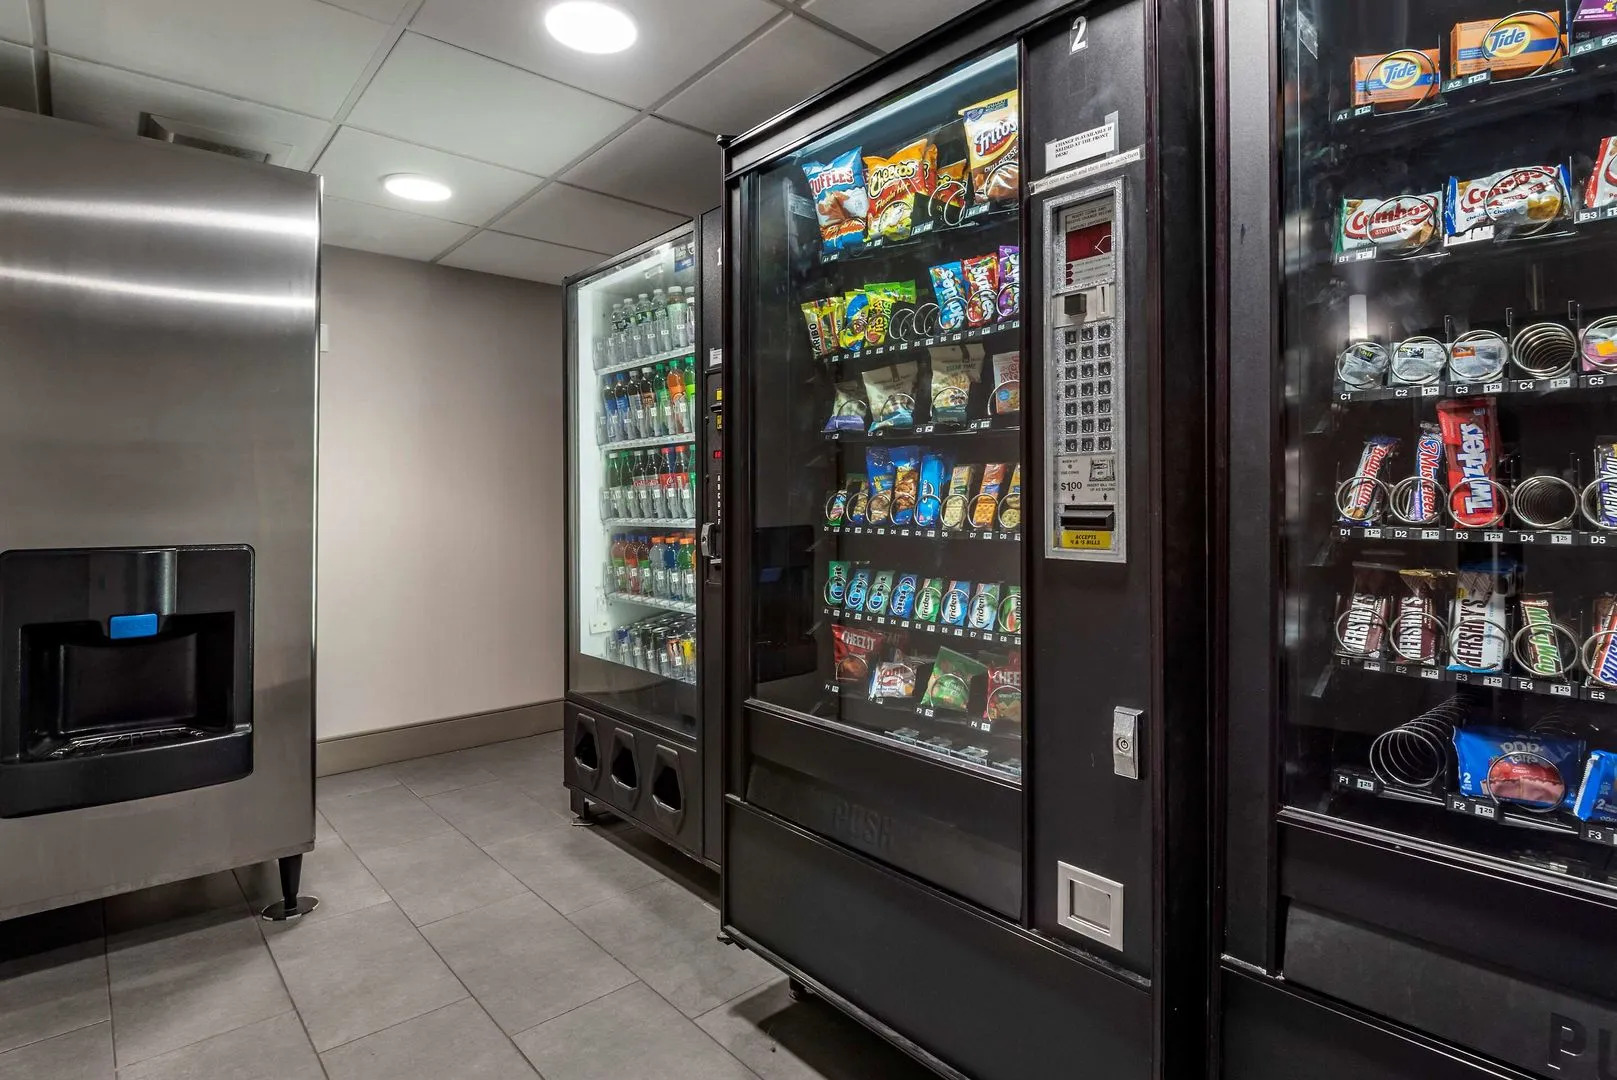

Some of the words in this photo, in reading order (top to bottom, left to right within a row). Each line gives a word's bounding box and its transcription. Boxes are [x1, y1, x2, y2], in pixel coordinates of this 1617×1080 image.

[1072, 15, 1087, 53] 2
[1489, 28, 1526, 52] Tide
[1576, 44, 1592, 53] A3
[1384, 62, 1417, 84] Tide
[1447, 81, 1462, 89] A2
[1337, 113, 1348, 121] A1
[974, 119, 1018, 157] Fritos
[868, 160, 918, 198] Cheetos
[1468, 165, 1556, 205] Combos
[1352, 200, 1429, 230] Combos
[1519, 382, 1534, 390] C4
[1589, 377, 1604, 385] C5
[1395, 389, 1408, 397] C2
[1455, 386, 1468, 394] C3
[1419, 439, 1439, 453] 3
[1457, 423, 1493, 515] Twizzlers
[1455, 532, 1468, 540] D3
[1520, 534, 1534, 542] D4
[1591, 536, 1606, 544] D5
[922, 588, 930, 618] Trident
[949, 590, 957, 621] Trident
[976, 592, 986, 626] Trident
[1343, 592, 1376, 653] HERSHEY'S
[1400, 596, 1423, 659] HERSHEY'S
[1455, 599, 1488, 668] HERSHEY'S
[1340, 658, 1350, 666] E1
[1395, 666, 1407, 674] E2
[1456, 673, 1468, 681] E3
[1520, 681, 1534, 690] E4
[1591, 691, 1605, 700] E5
[1339, 775, 1349, 785] F1
[1463, 772, 1472, 784] 2
[1453, 801, 1465, 811] F2
[1588, 829, 1602, 840] F3
